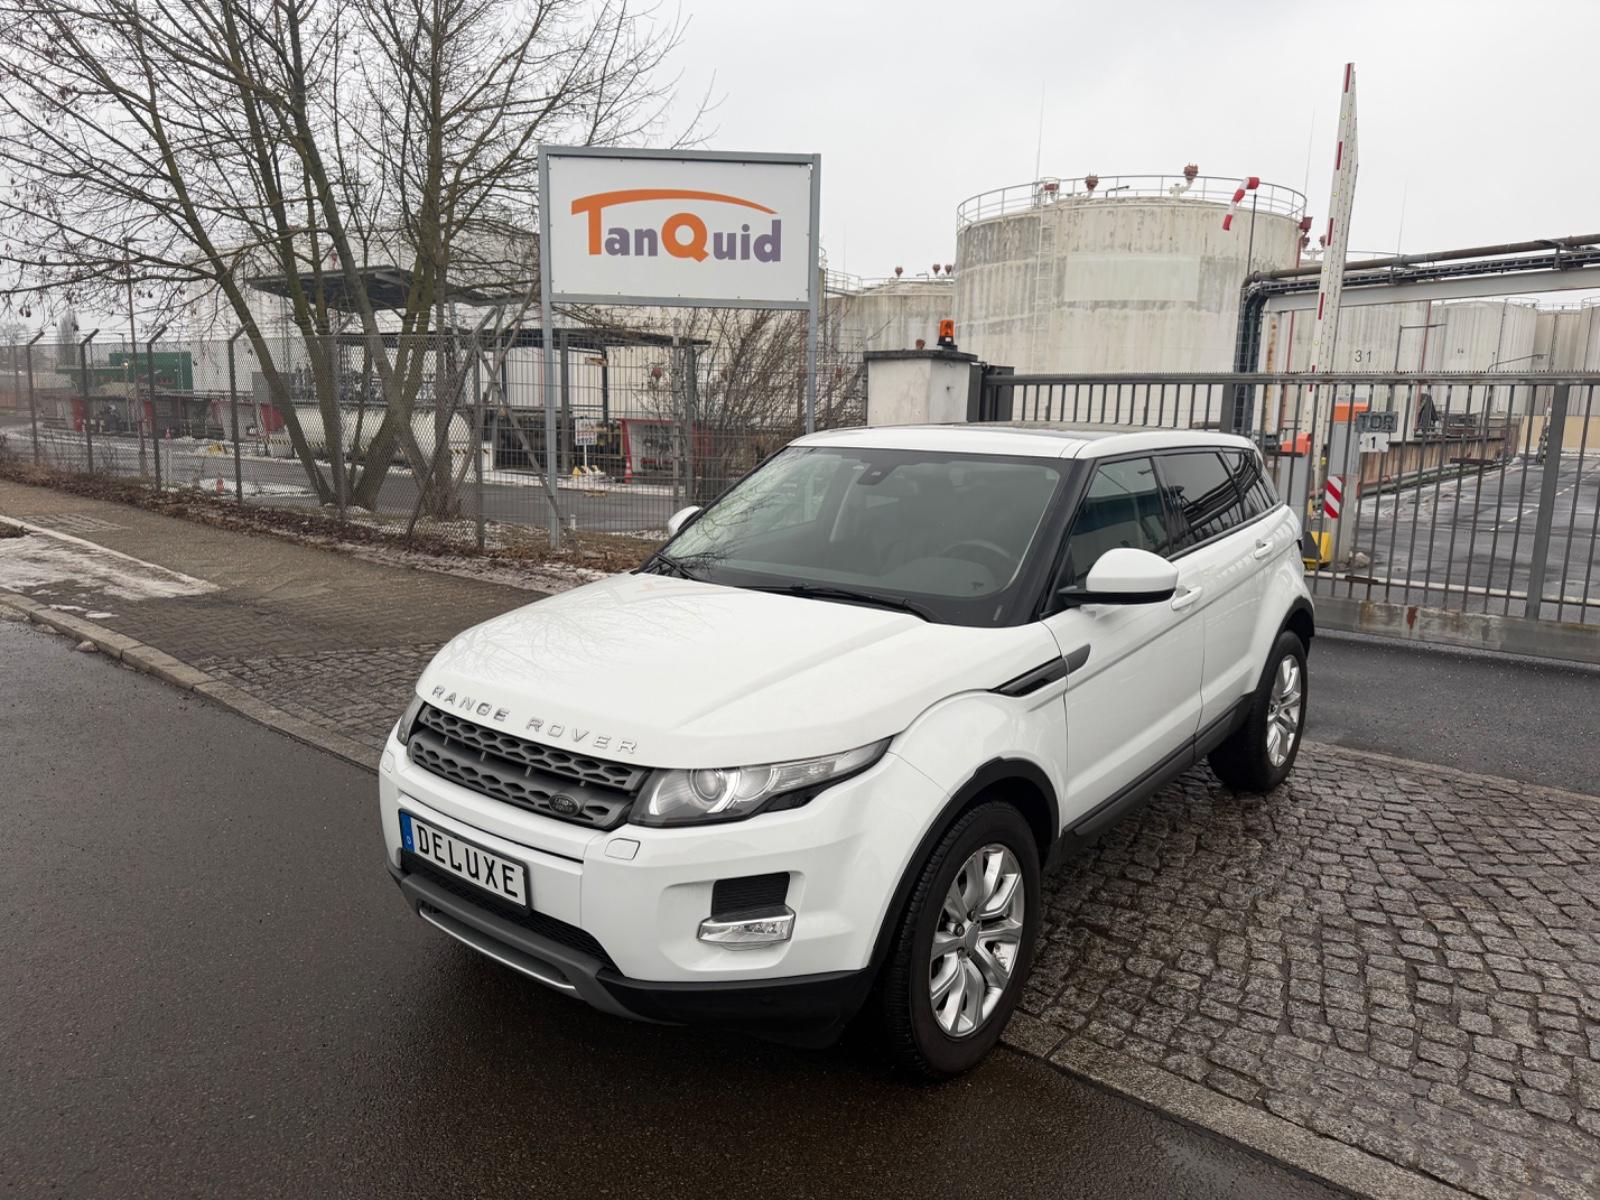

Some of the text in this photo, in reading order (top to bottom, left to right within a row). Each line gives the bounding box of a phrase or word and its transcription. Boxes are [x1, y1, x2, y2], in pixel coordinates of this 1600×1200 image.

[571, 189, 781, 263] TanQuid
[1359, 415, 1395, 430] TOR
[432, 685, 637, 754] RANGE ROVER
[416, 824, 518, 898] DELUXE
